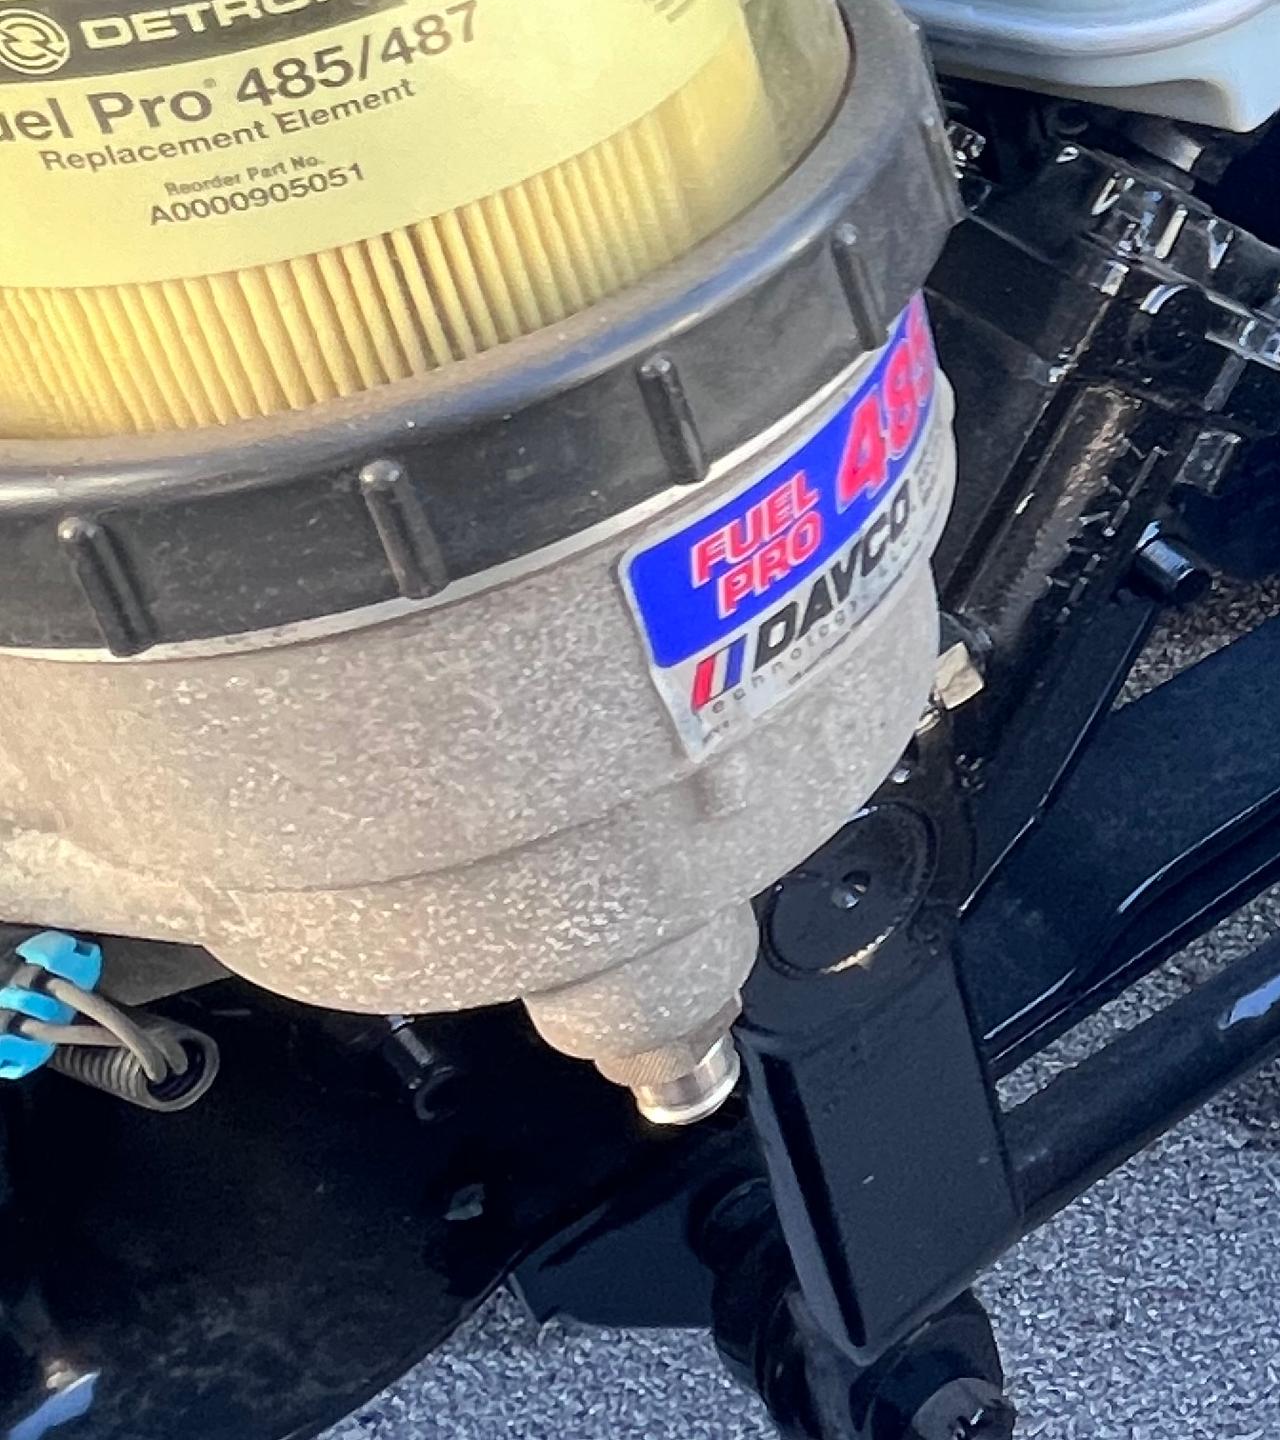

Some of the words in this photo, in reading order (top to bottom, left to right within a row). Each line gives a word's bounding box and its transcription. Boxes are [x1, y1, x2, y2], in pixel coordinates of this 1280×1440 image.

[39, 120, 270, 173] Replacement
[273, 77, 416, 136] Element
[149, 162, 365, 226] A0000905051
[163, 172, 242, 197] Reorder
[246, 162, 288, 182] Part
[691, 470, 821, 589] FUEL
[718, 510, 825, 620] PRO
[753, 478, 910, 673] DAVCO
